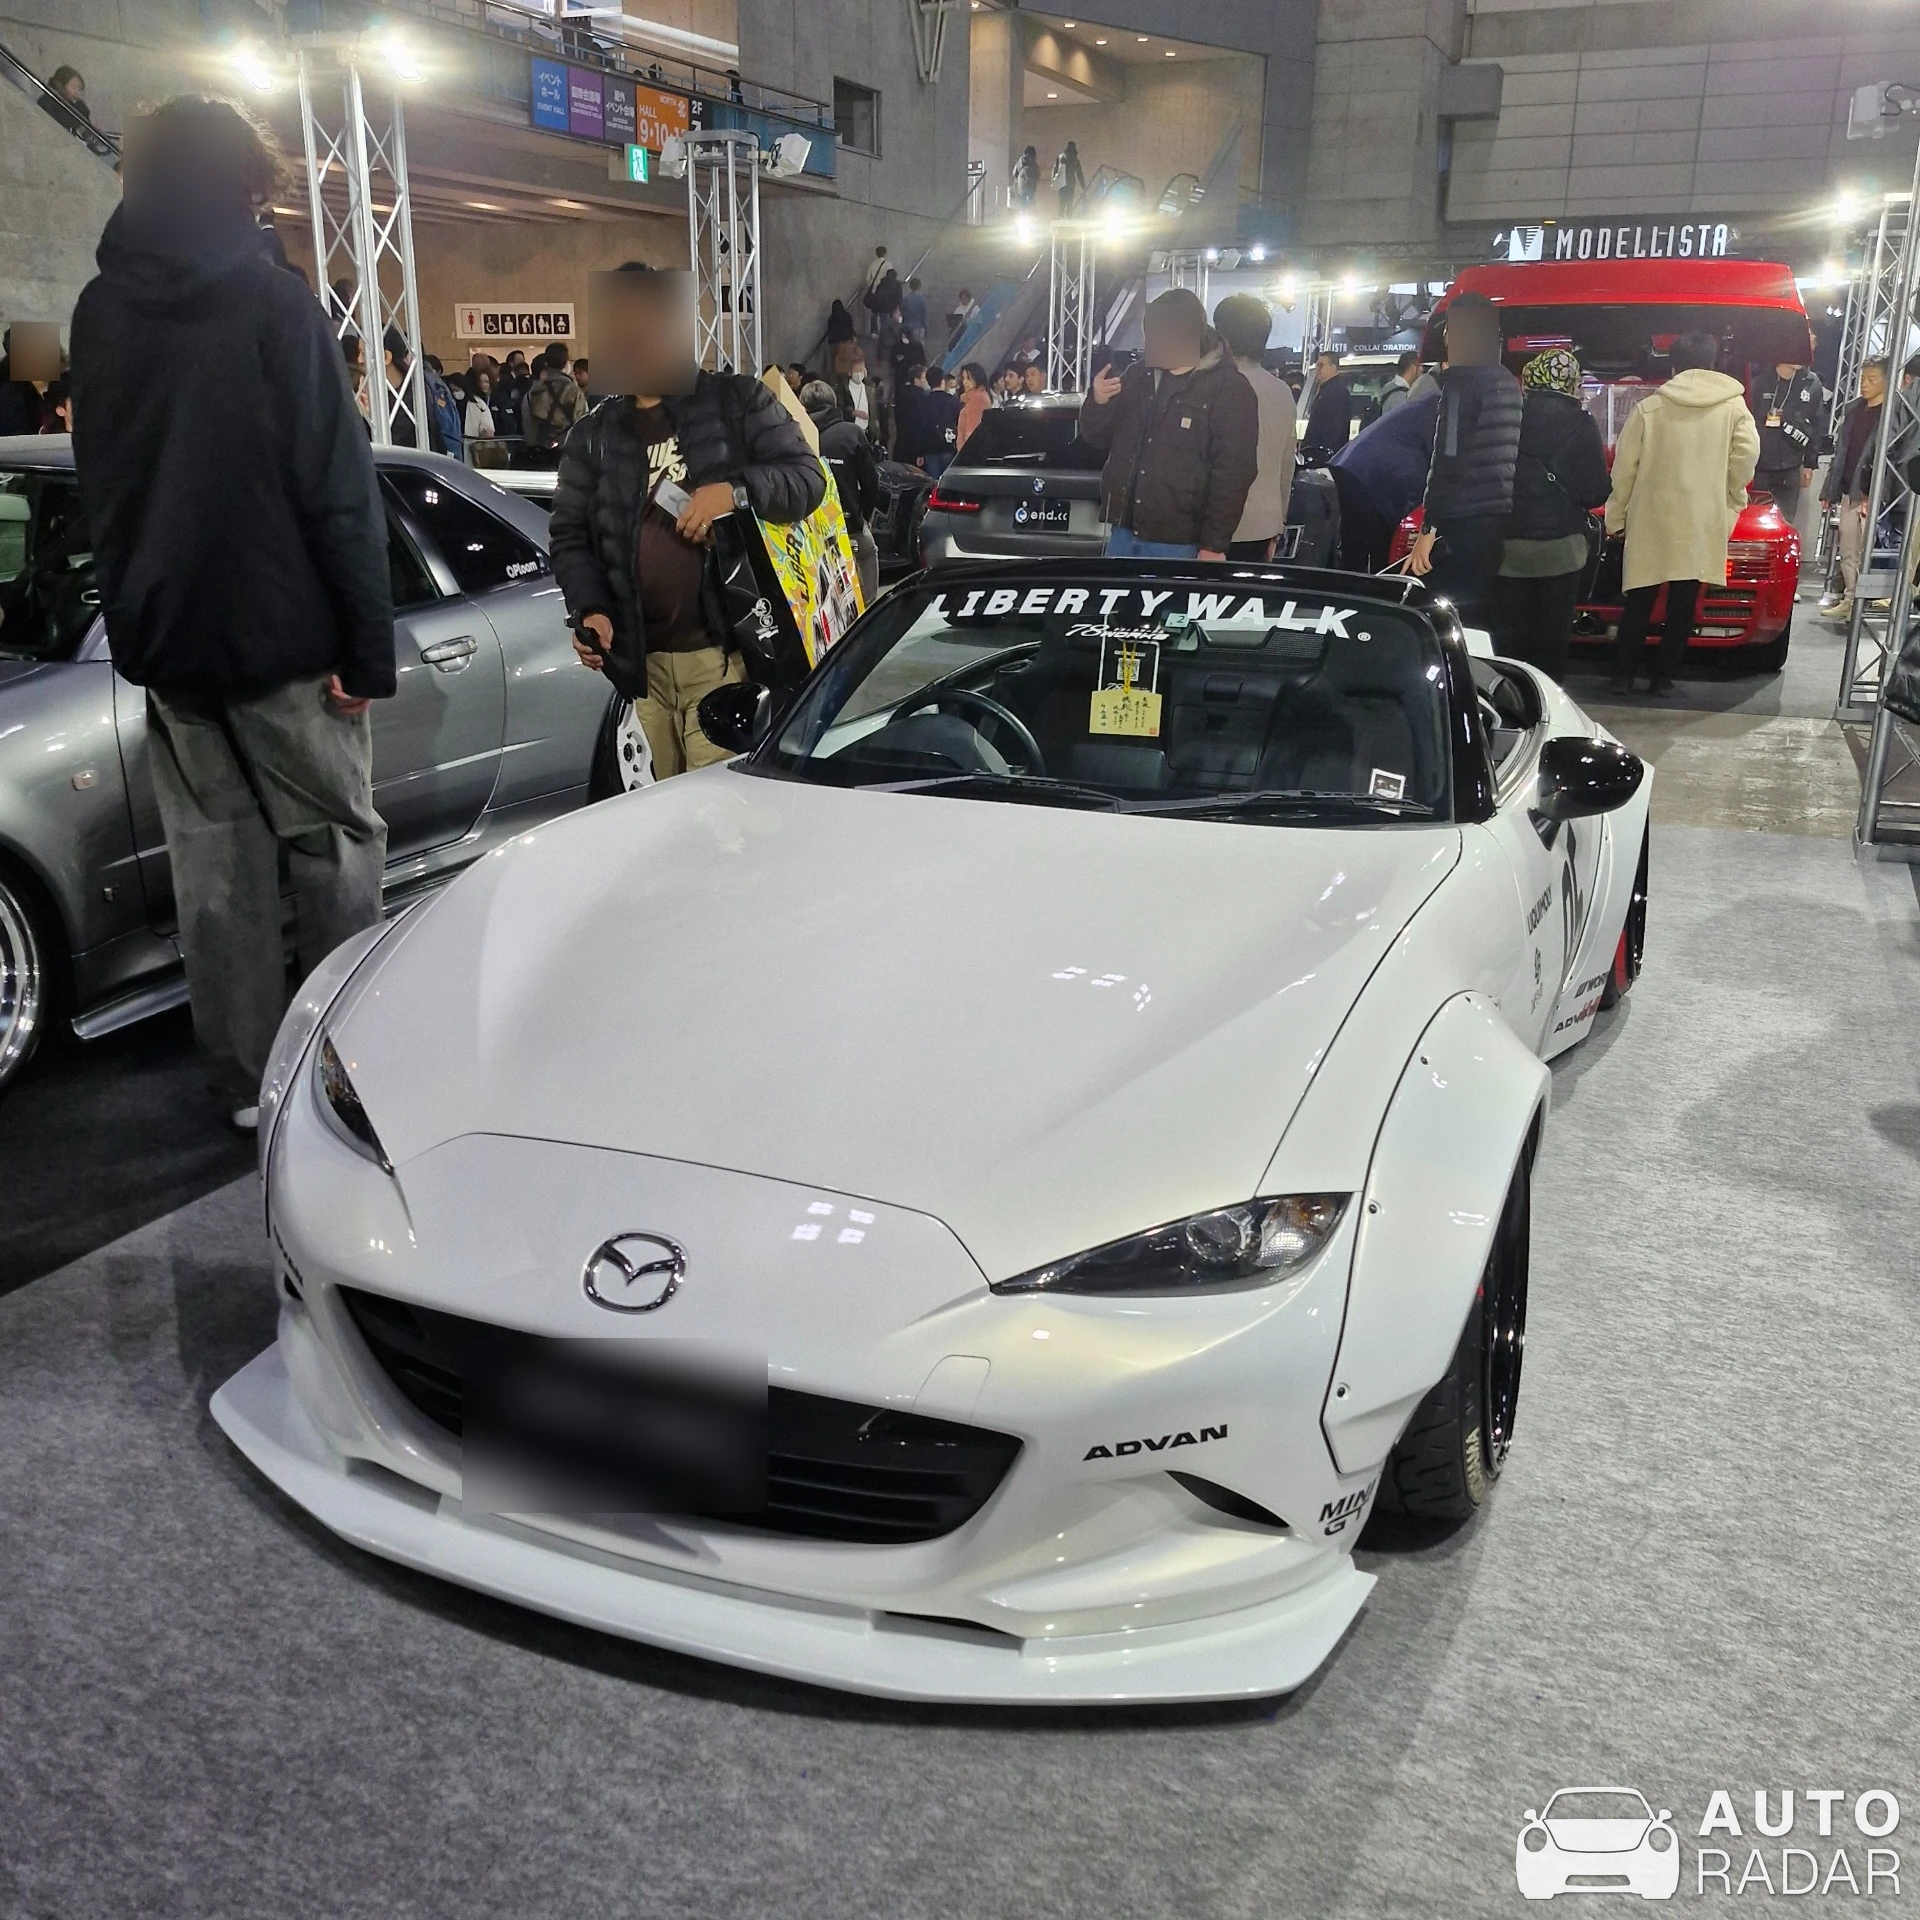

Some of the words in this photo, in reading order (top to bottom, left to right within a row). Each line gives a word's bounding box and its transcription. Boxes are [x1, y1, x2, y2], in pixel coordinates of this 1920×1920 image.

[538, 72, 562, 87] イベント
[541, 86, 561, 101] ホール
[640, 104, 657, 119] HALL
[677, 100, 687, 118] 北
[691, 100, 703, 115] 2F
[1555, 224, 1728, 260] MODELLISTA
[923, 588, 1171, 618] LIBERTY
[1186, 592, 1359, 638] WALK
[1083, 1424, 1228, 1461] ADVAN
